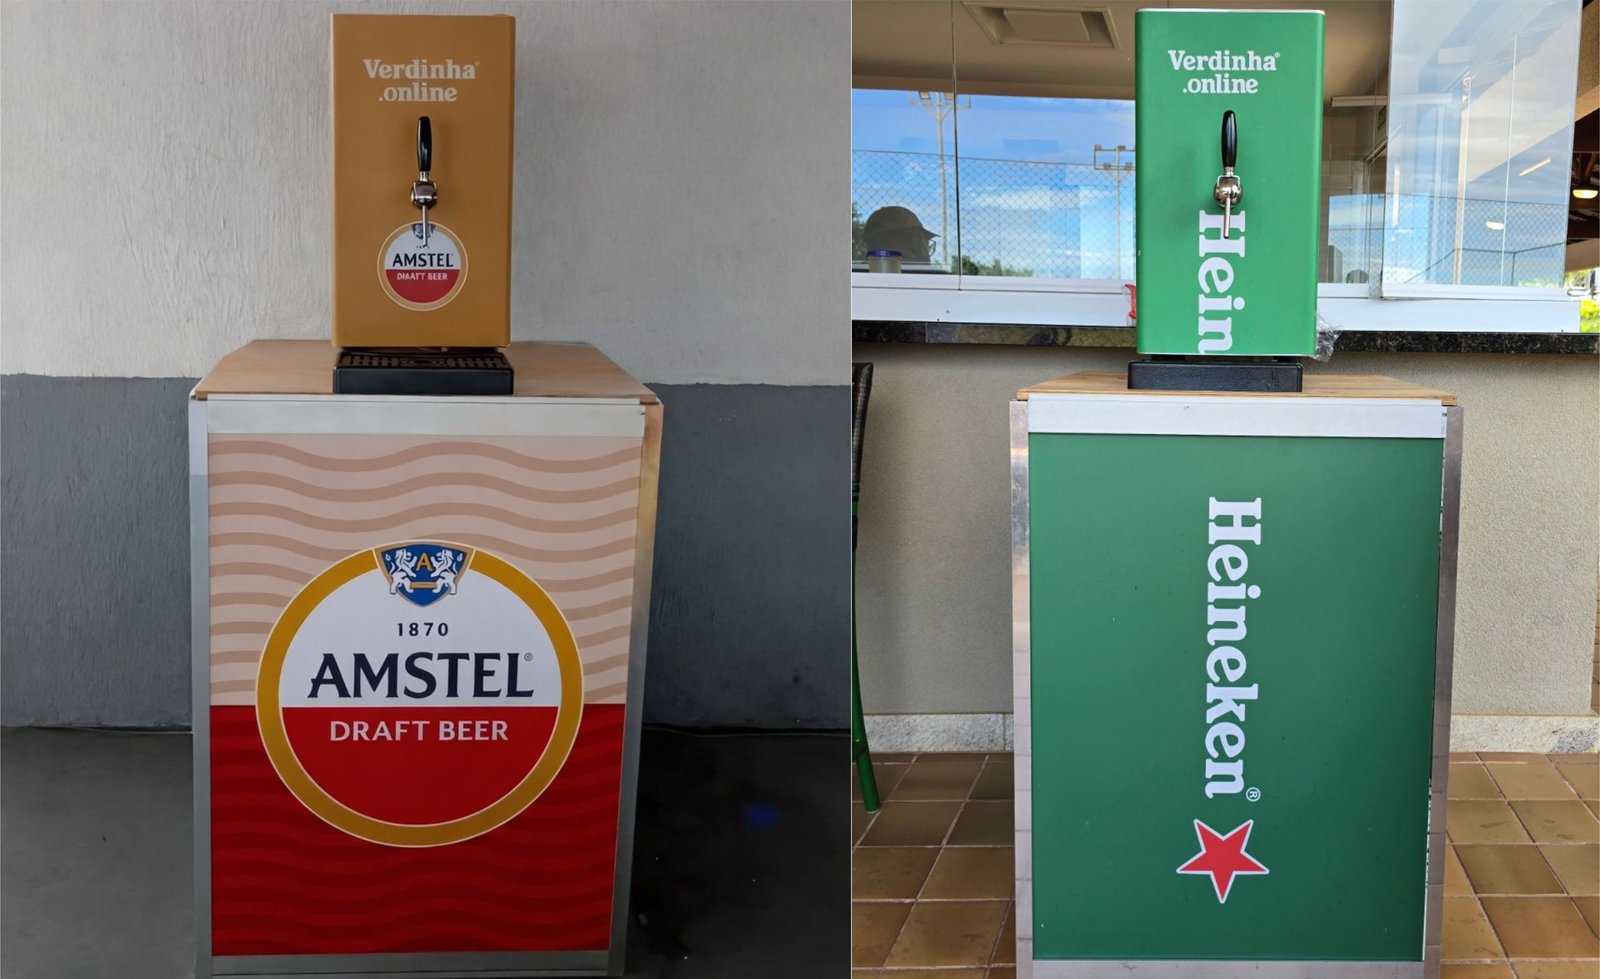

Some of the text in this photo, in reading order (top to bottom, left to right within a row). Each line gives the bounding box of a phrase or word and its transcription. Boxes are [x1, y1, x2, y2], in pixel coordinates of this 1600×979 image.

[379, 82, 457, 102] .online
[1183, 74, 1258, 94] .online
[392, 253, 454, 267] AMSTEL
[1198, 210, 1246, 354] Hein
[397, 622, 449, 636] 1870
[330, 720, 509, 741] DRAFT BEER
